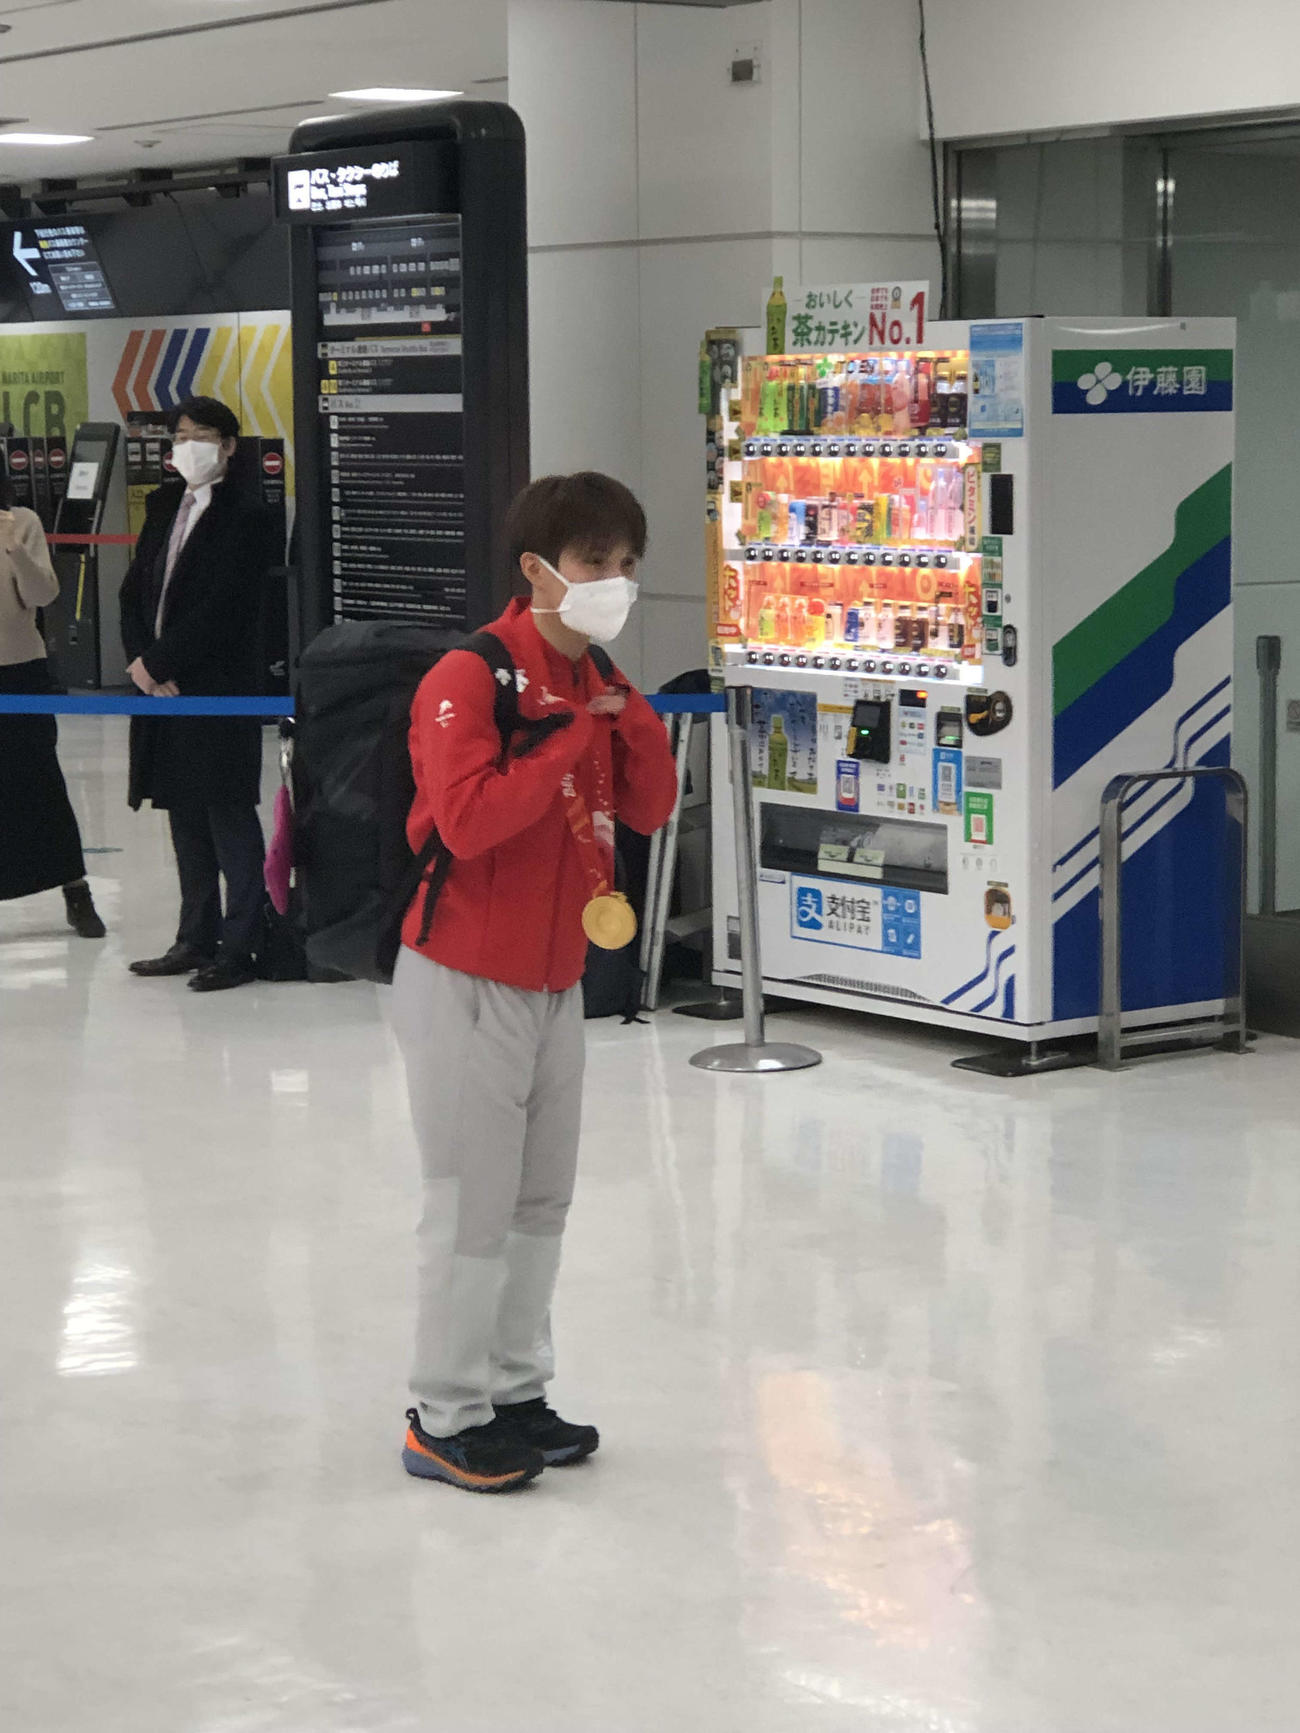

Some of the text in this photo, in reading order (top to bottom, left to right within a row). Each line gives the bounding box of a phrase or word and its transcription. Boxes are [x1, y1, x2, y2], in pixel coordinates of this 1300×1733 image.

[805, 289, 853, 309] おいしく
[792, 313, 865, 347] 茶カテキン
[869, 291, 925, 345] No.1
[1126, 366, 1206, 396] 伊藤園
[826, 894, 871, 922] 支付宝
